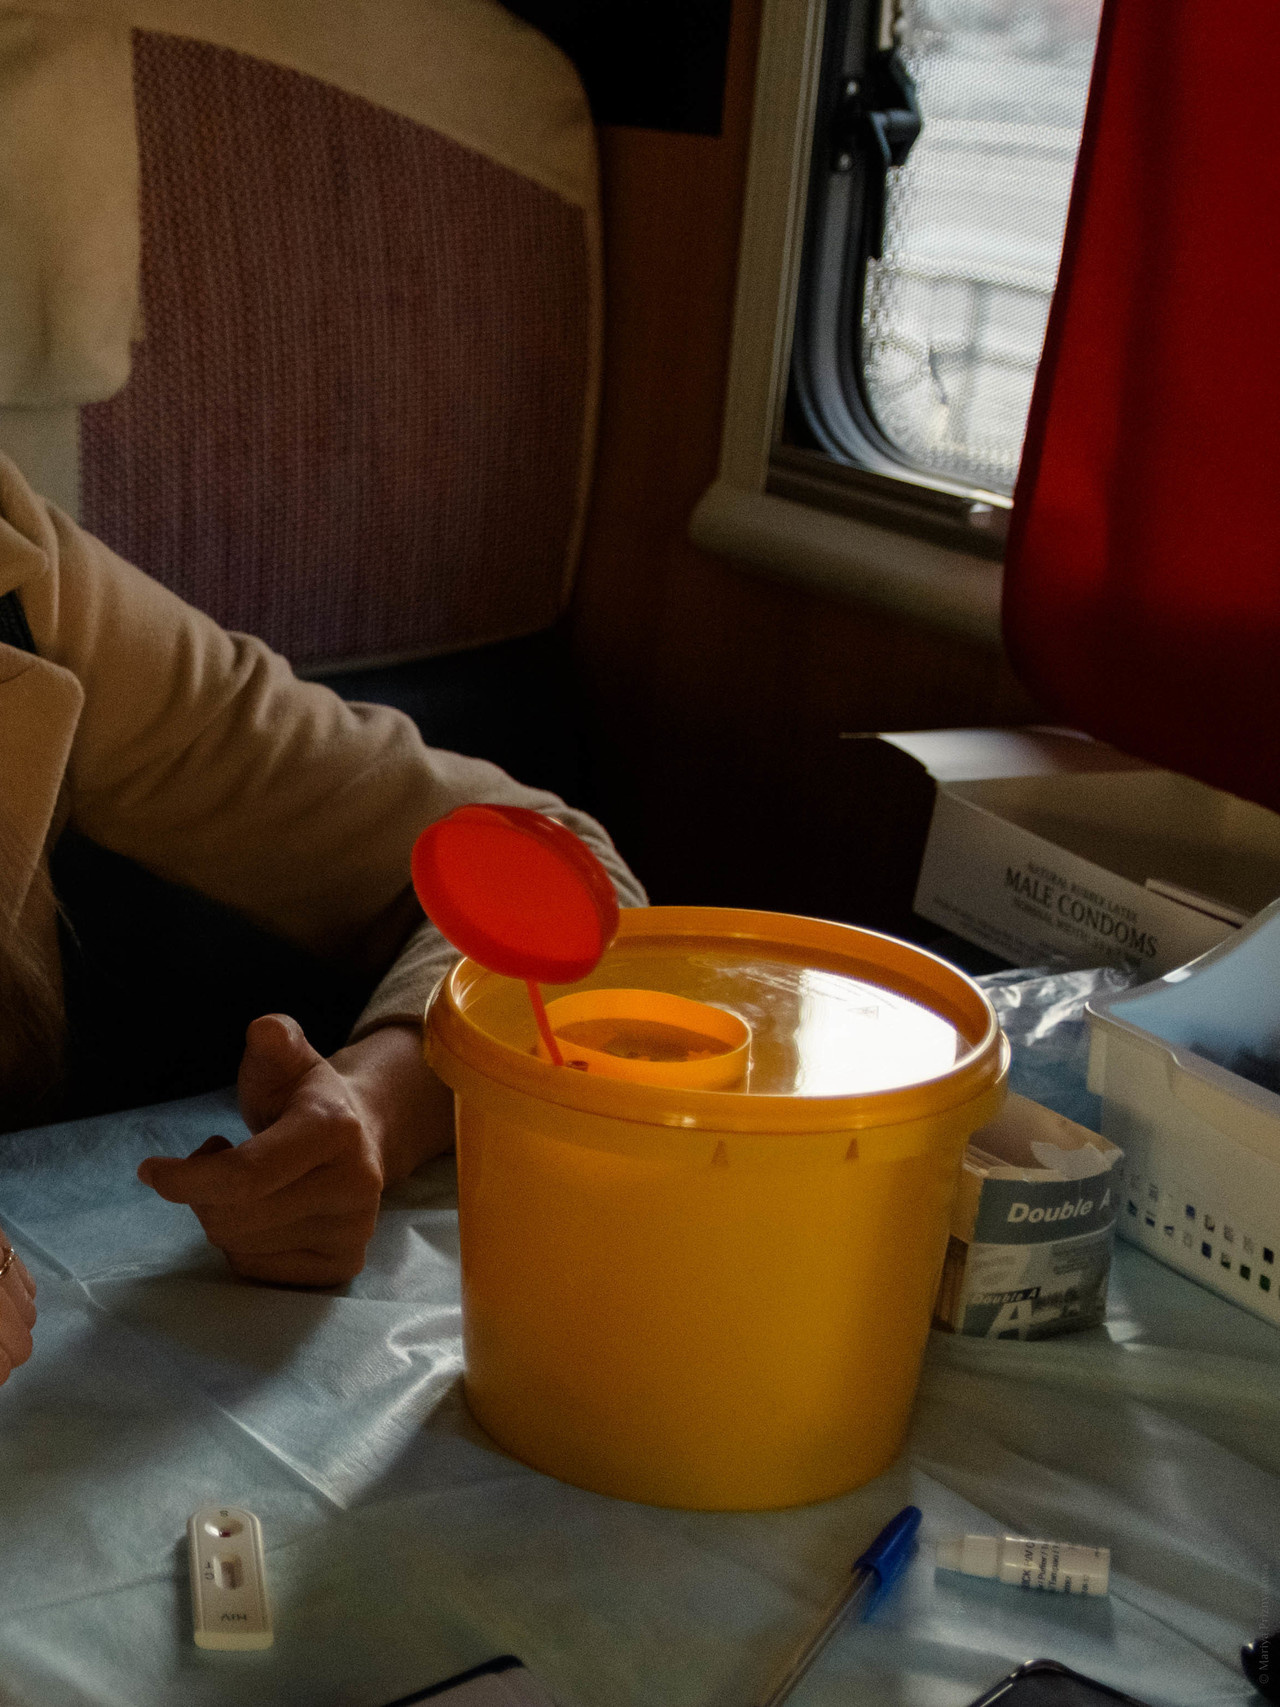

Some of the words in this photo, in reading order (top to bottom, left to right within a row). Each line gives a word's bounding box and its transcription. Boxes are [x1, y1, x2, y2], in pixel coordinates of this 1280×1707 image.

[1006, 867, 1053, 908] MALE
[1057, 893, 1158, 959] CONDOMS
[1006, 1198, 1094, 1224] Double
[1099, 1187, 1111, 1212] A
[220, 1613, 247, 1622] HIV
